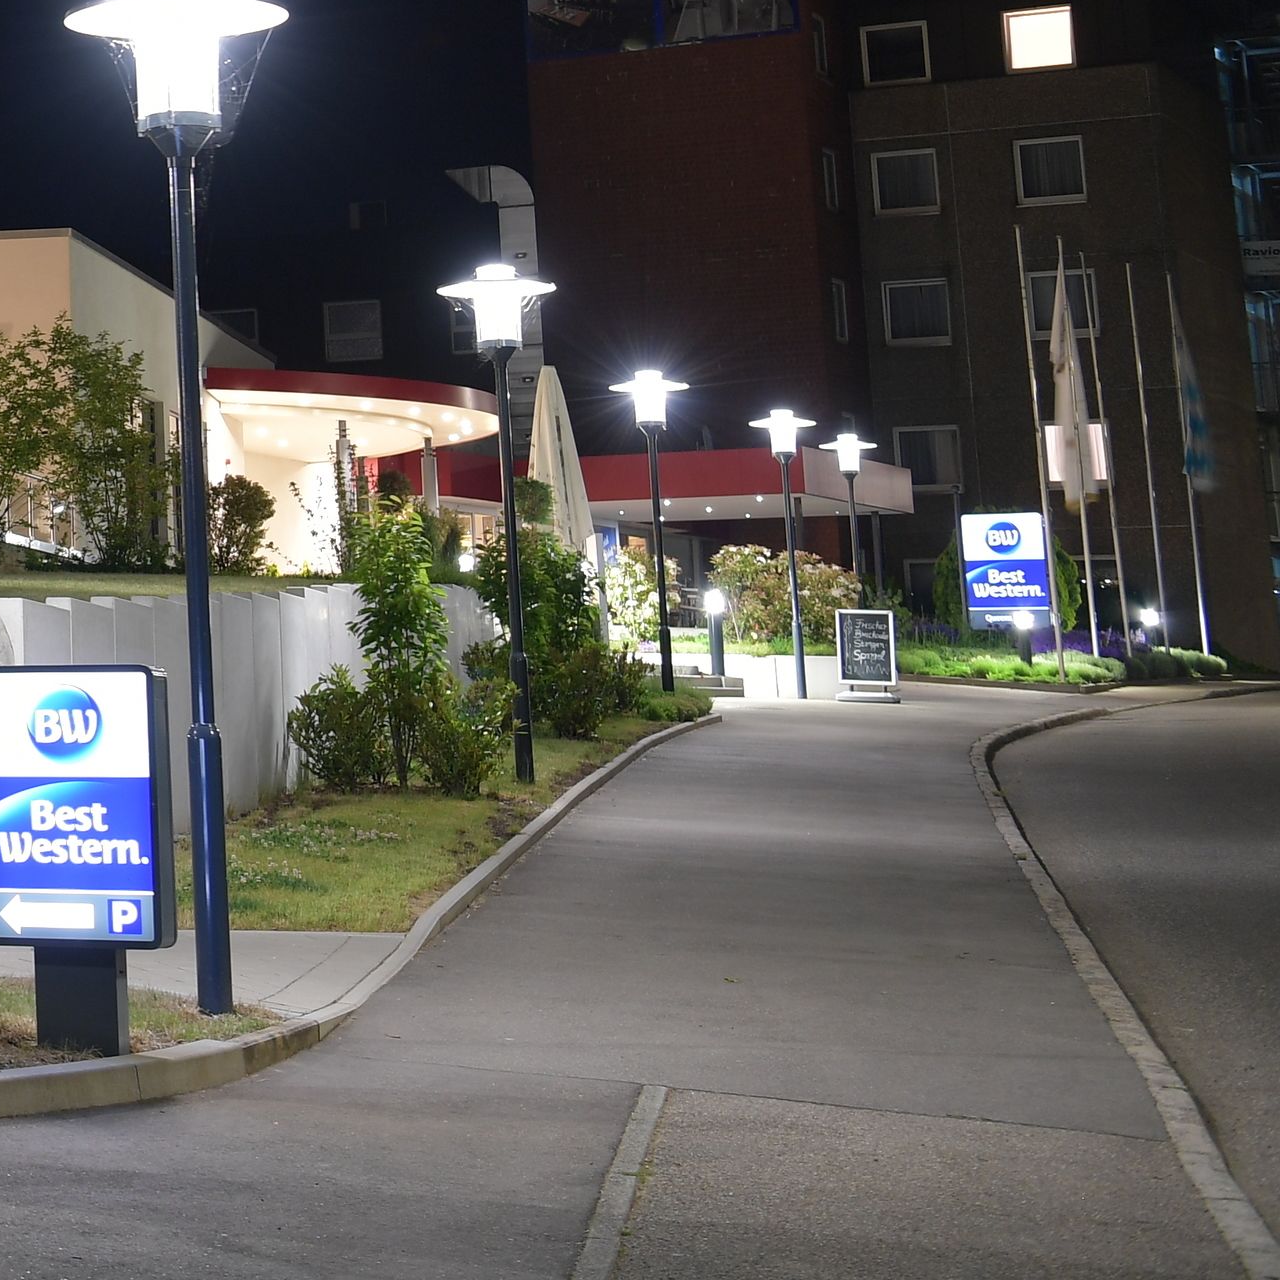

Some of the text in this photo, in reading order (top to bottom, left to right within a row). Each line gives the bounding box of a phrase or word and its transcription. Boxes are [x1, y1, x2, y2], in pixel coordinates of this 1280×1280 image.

[986, 529, 1019, 547] BW
[987, 568, 1026, 584] Best
[33, 708, 98, 745] BW
[30, 800, 109, 832] Best
[111, 901, 138, 934] P
